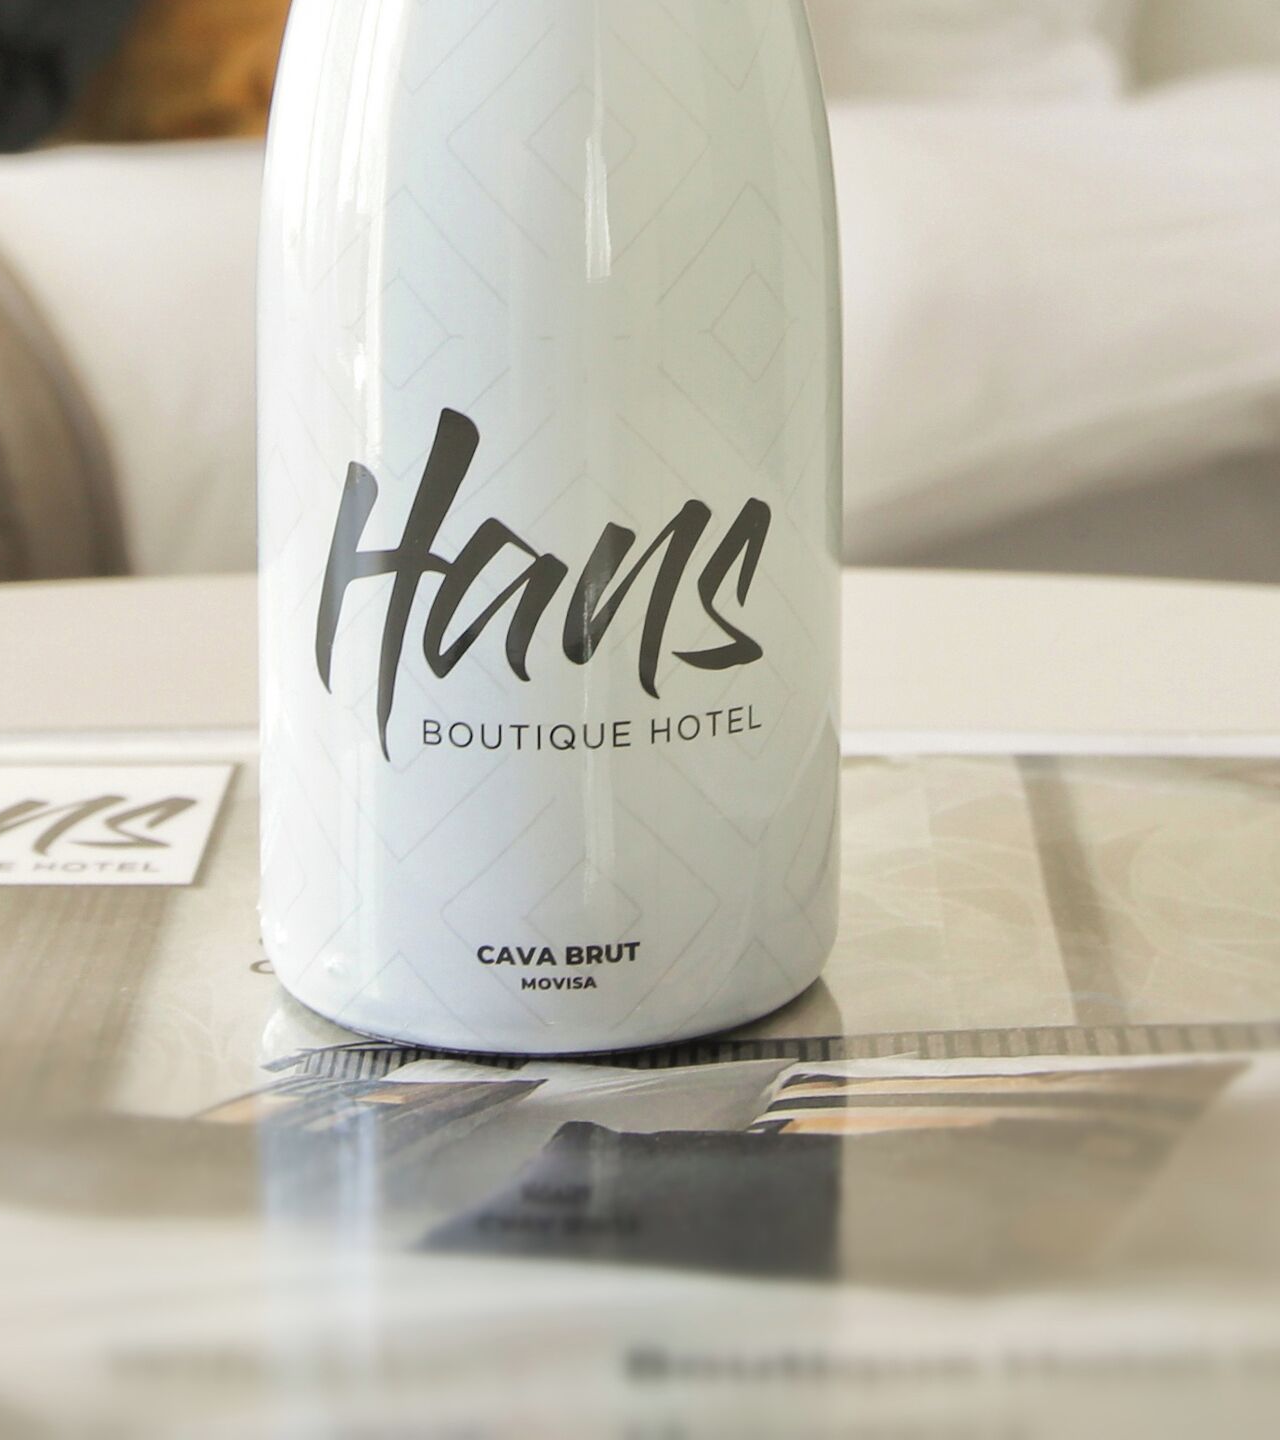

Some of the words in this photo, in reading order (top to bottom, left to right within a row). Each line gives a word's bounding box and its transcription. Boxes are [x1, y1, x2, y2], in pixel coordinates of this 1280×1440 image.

[315, 407, 772, 763] Hans
[422, 718, 632, 751] BOUTIQUE
[650, 704, 763, 745] HOTEL
[32, 861, 161, 873] HOTEL
[476, 944, 558, 967] CAVA
[565, 941, 641, 966] BRUT
[520, 976, 598, 991] MOVISA
